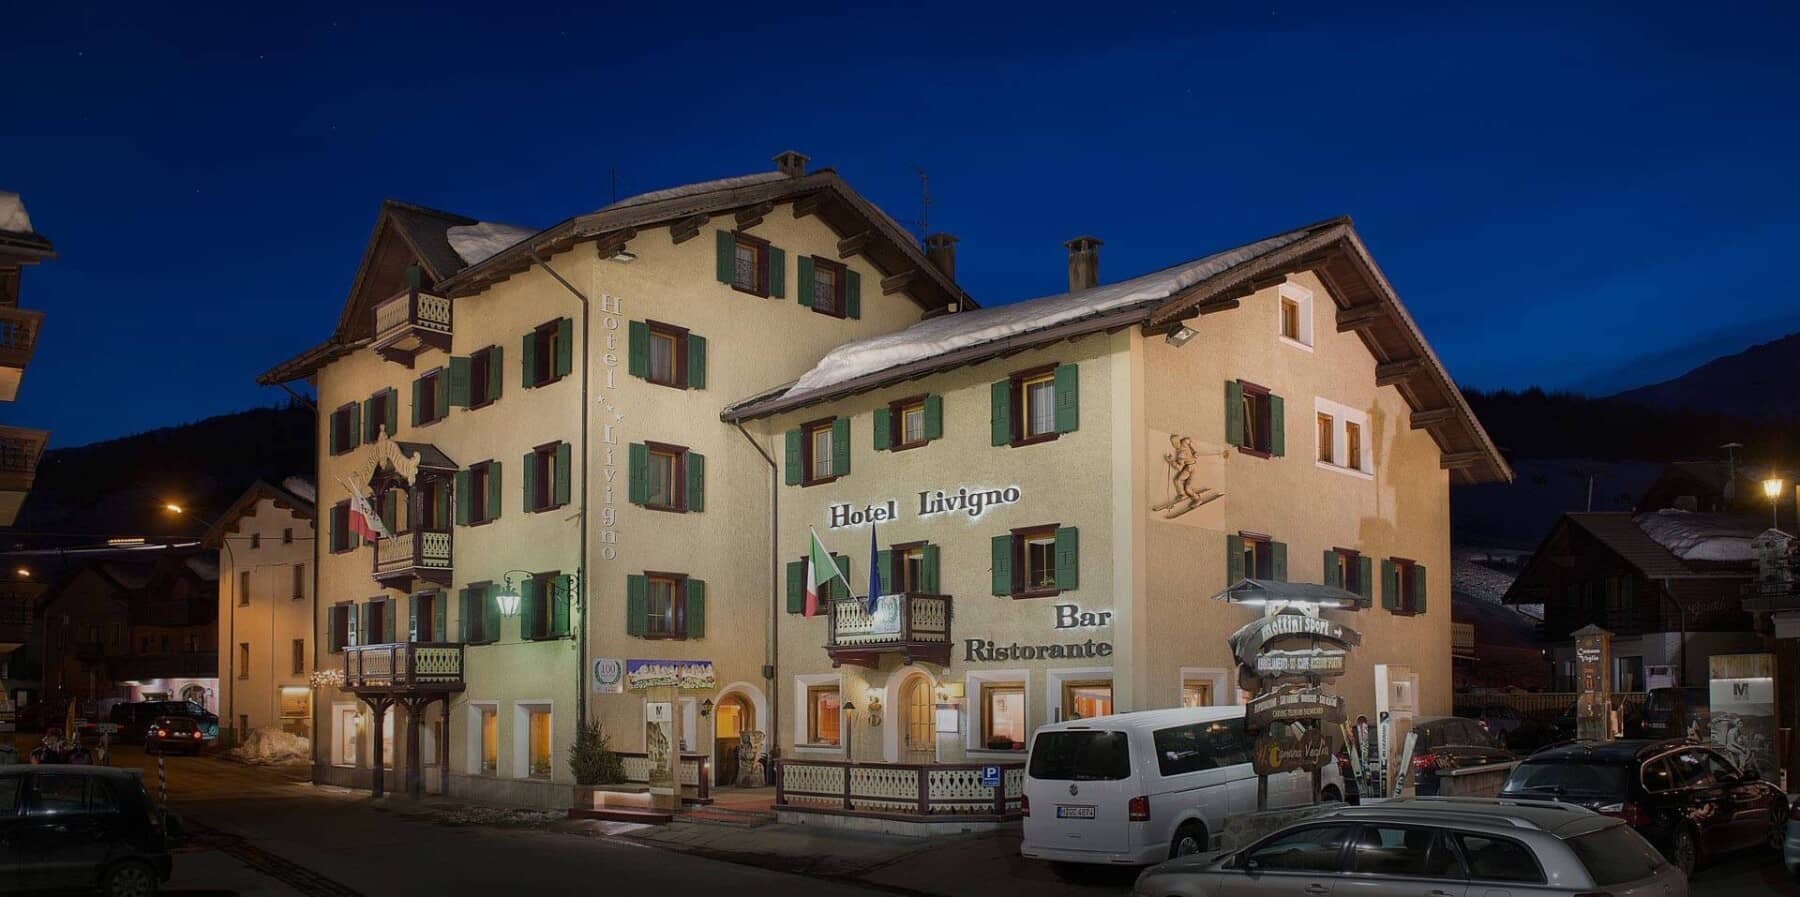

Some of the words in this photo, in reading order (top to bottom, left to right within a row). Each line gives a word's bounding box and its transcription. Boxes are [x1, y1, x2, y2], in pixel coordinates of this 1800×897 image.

[601, 294, 622, 389] Hotel
[601, 425, 618, 560] Livigno
[830, 500, 896, 529] Hotel
[917, 486, 1020, 516] Livigno
[1054, 604, 1112, 629] Bar
[963, 637, 1113, 662] Ristorante
[987, 767, 997, 778] P
